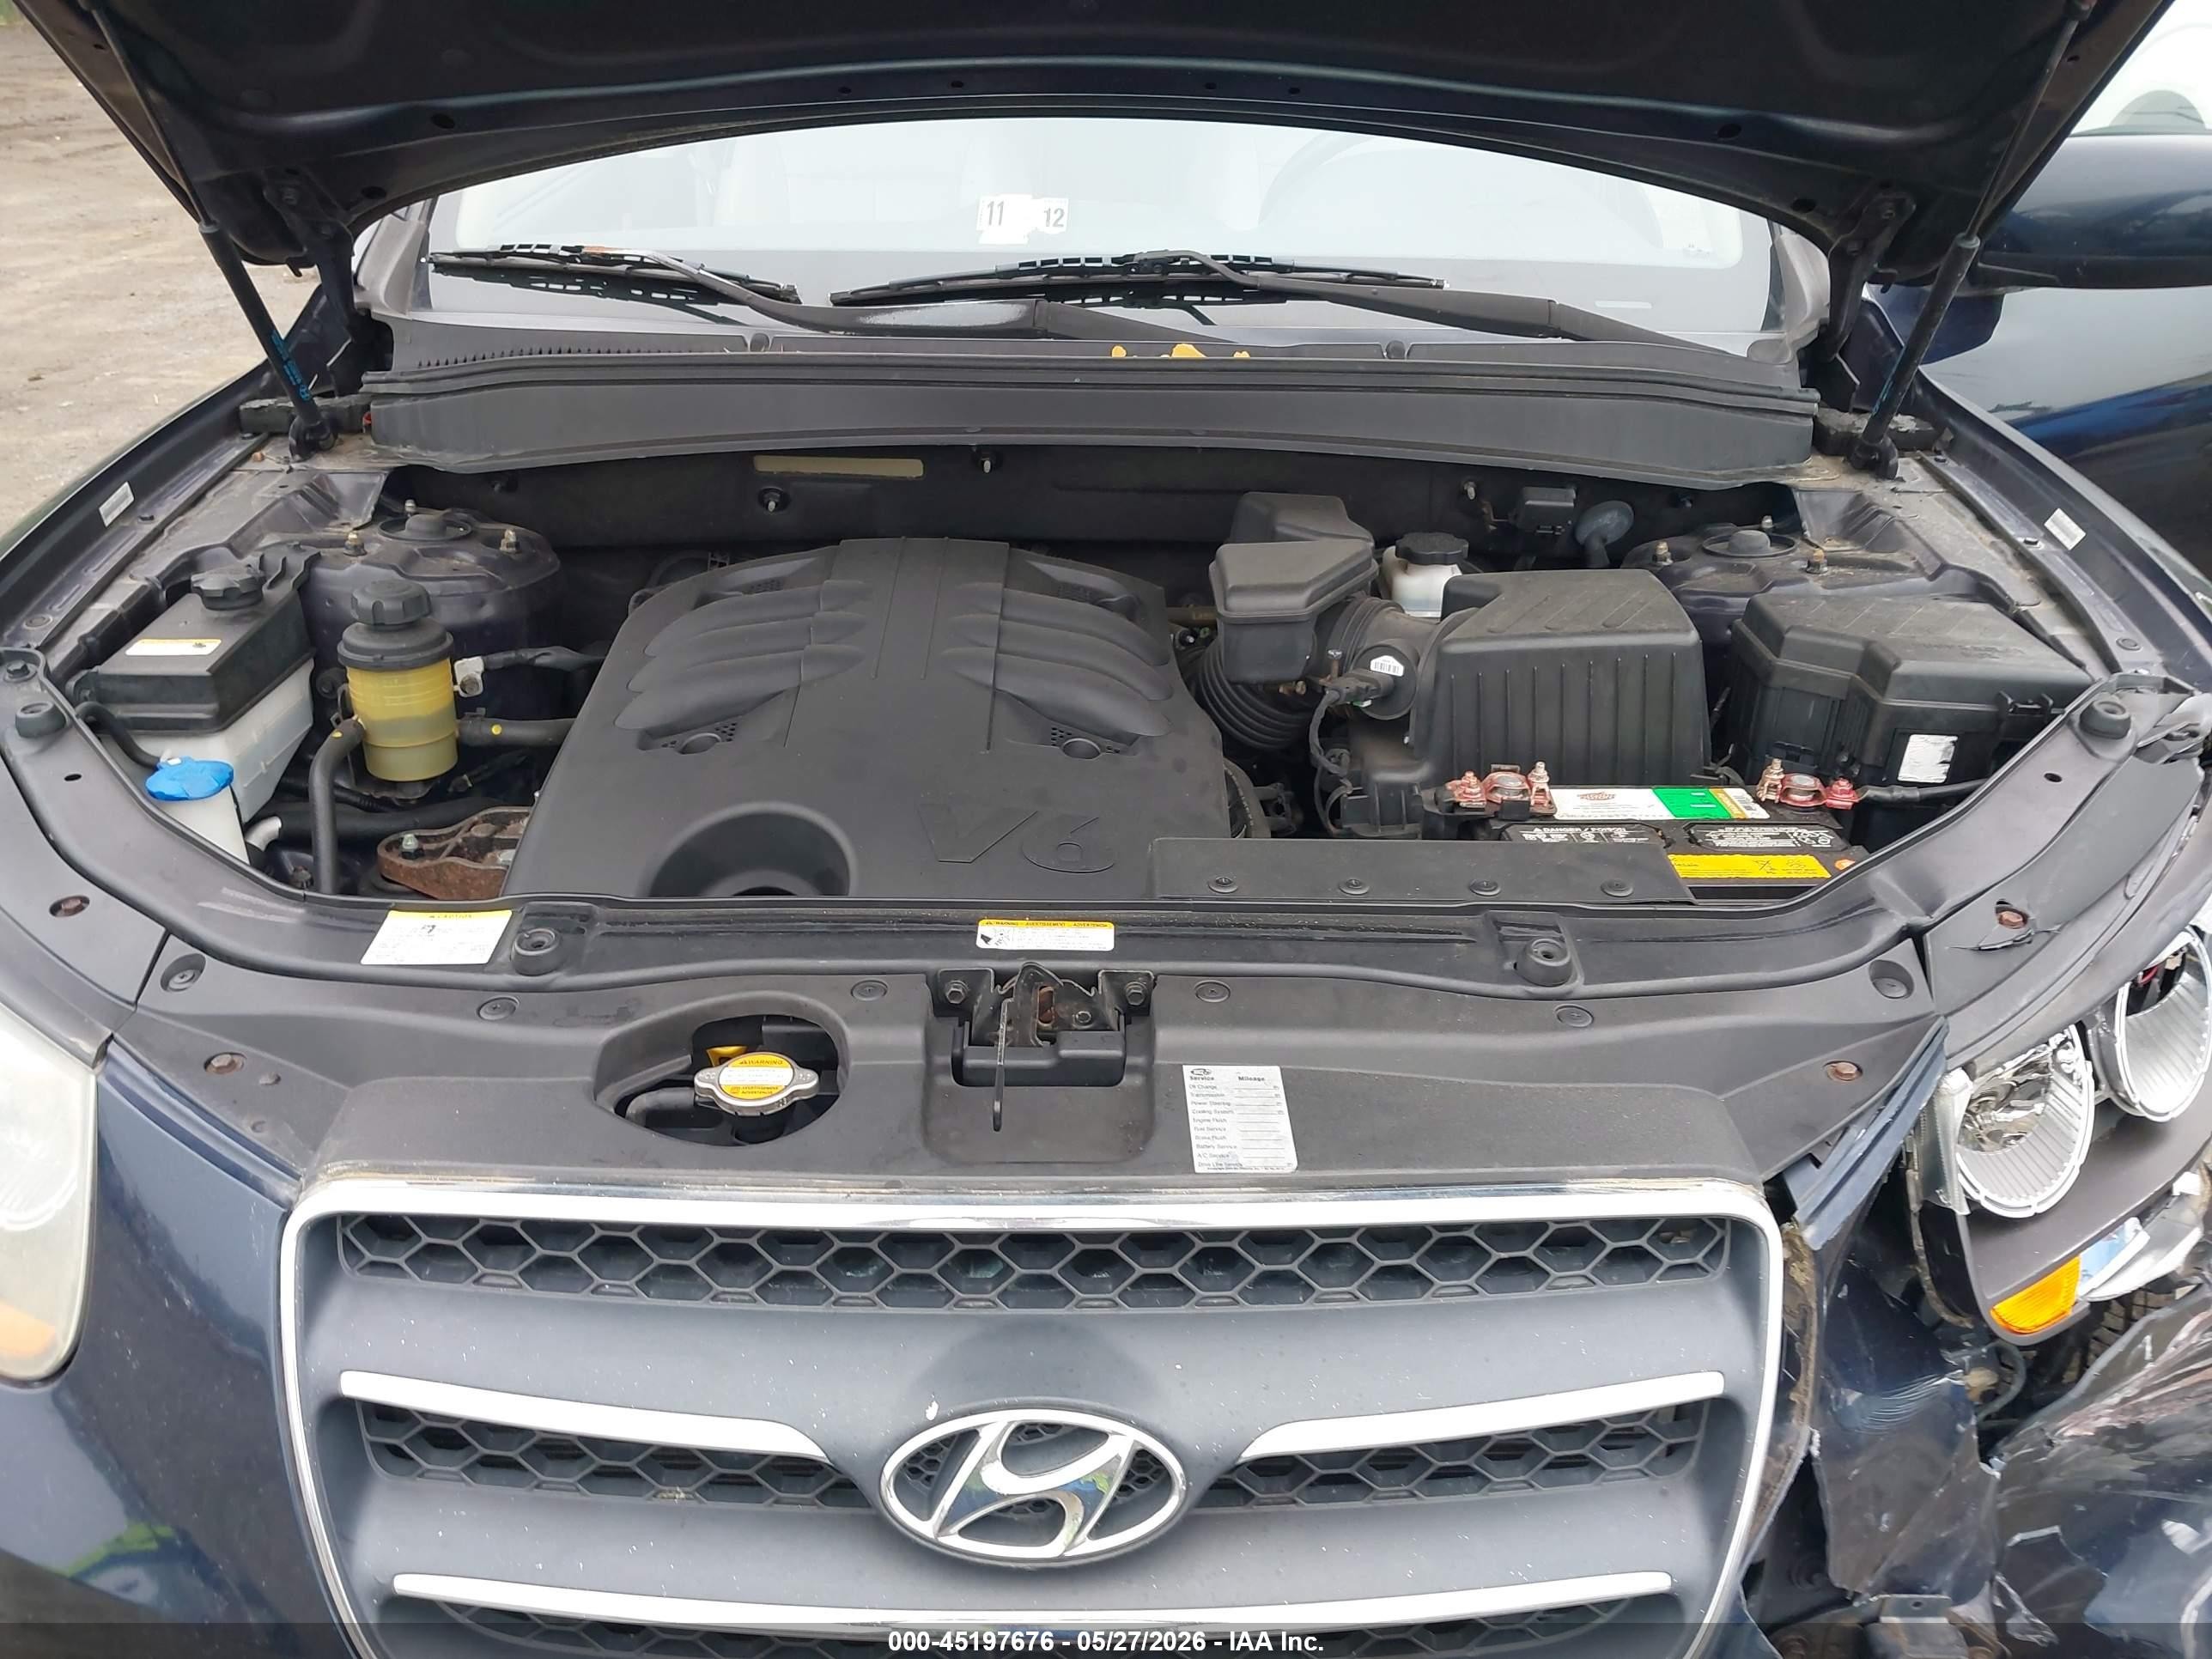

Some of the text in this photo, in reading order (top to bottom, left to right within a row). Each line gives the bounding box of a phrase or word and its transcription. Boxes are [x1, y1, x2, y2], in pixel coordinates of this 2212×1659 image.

[987, 199, 1005, 227] 11
[1043, 206, 1065, 228] 12
[915, 803, 1115, 874] V6
